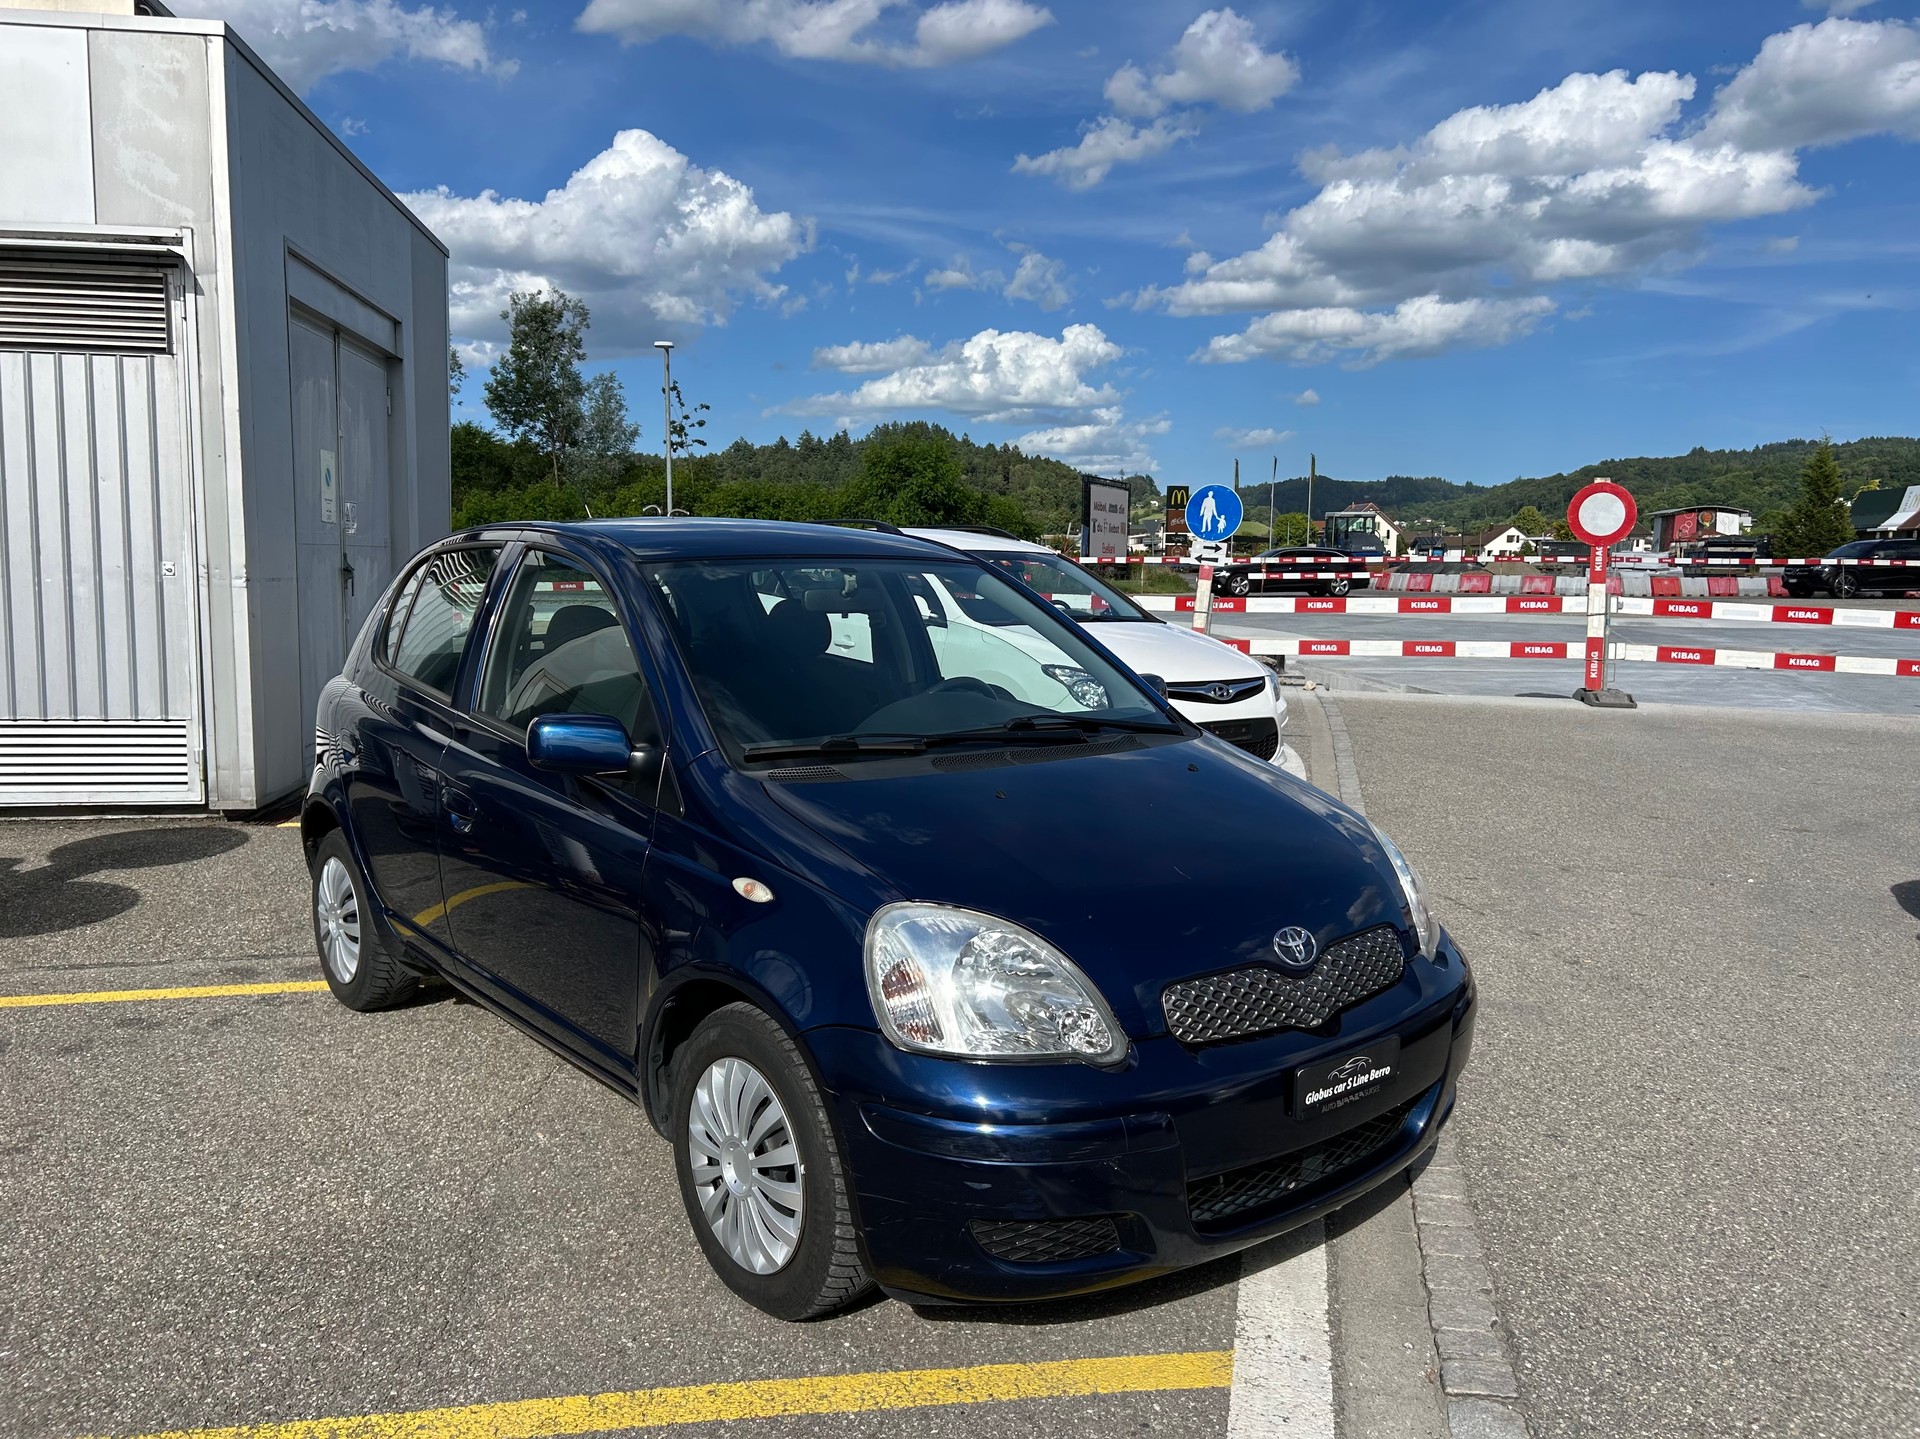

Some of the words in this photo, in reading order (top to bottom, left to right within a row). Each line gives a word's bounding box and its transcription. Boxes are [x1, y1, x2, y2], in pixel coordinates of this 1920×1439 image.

[1307, 601, 1334, 609] KIBAG
[1410, 601, 1439, 609] KIBAG
[1519, 601, 1549, 609] KIBAG
[1667, 604, 1699, 614] KIBAG
[1787, 610, 1819, 620] KIBAG
[1311, 644, 1338, 652] KIBAG
[1415, 645, 1443, 653] KIBAG
[1524, 646, 1554, 654] KIBAG
[1670, 651, 1701, 661] KIBAG
[1589, 651, 1599, 679] KIBAG
[1788, 657, 1820, 667] KIBAG
[1305, 1087, 1333, 1105] Globus
[1334, 1082, 1346, 1094] car
[1346, 1077, 1352, 1089] S
[1353, 1074, 1369, 1087] Line
[1370, 1066, 1390, 1080] Berro
